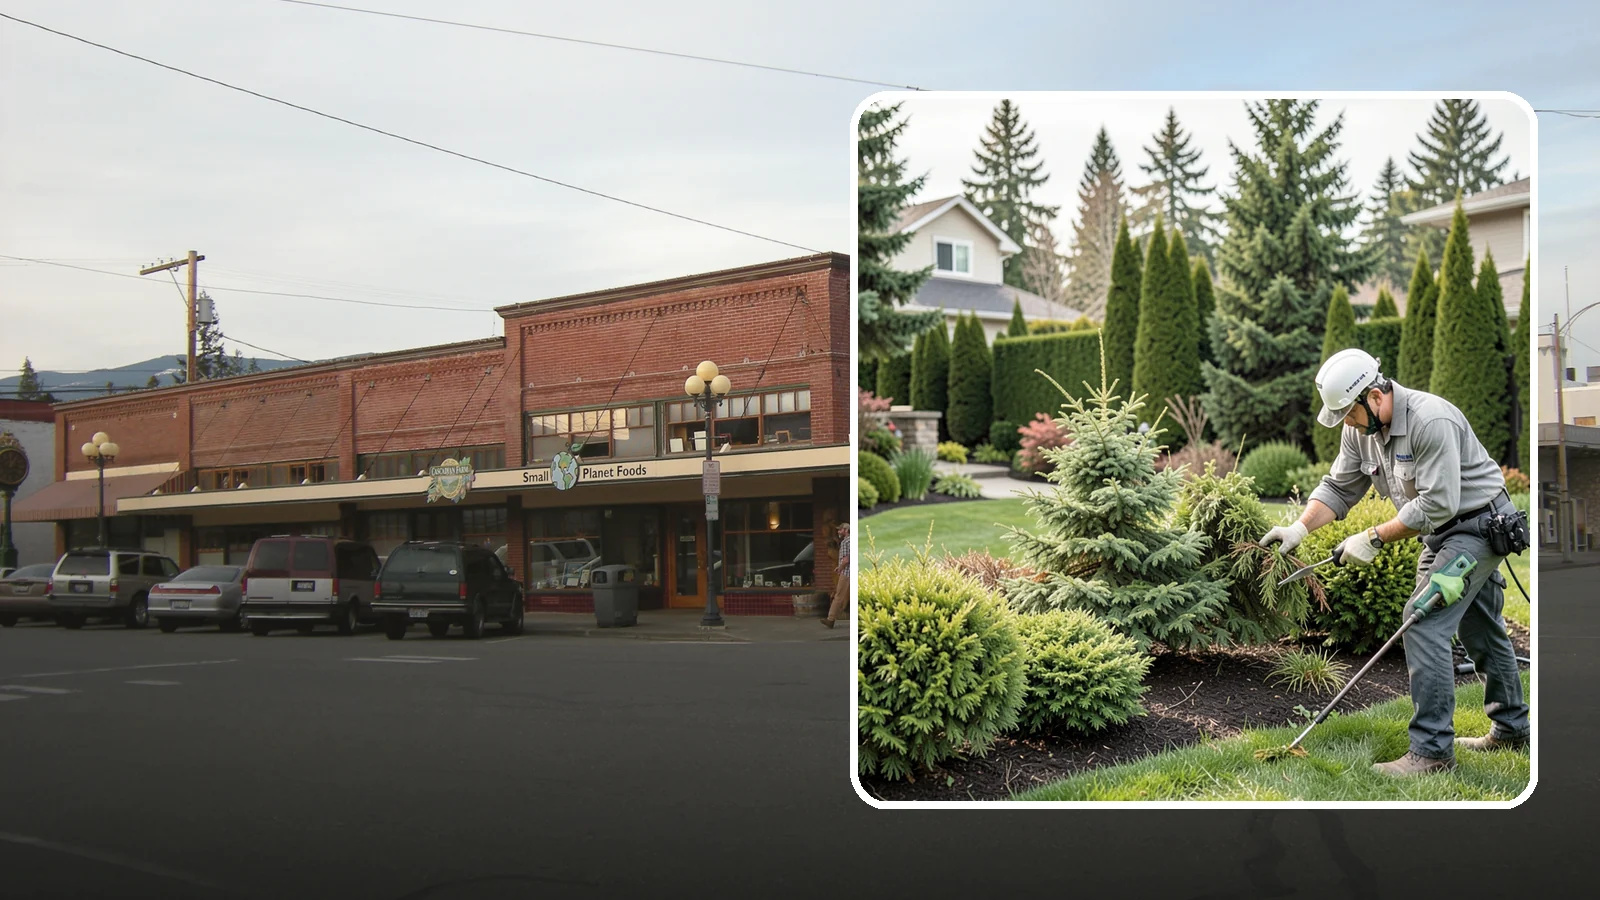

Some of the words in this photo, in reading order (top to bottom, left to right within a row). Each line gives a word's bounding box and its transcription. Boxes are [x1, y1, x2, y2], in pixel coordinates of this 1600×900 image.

[523, 471, 549, 482] Small
[583, 468, 613, 479] Planet
[617, 464, 647, 477] Foods
